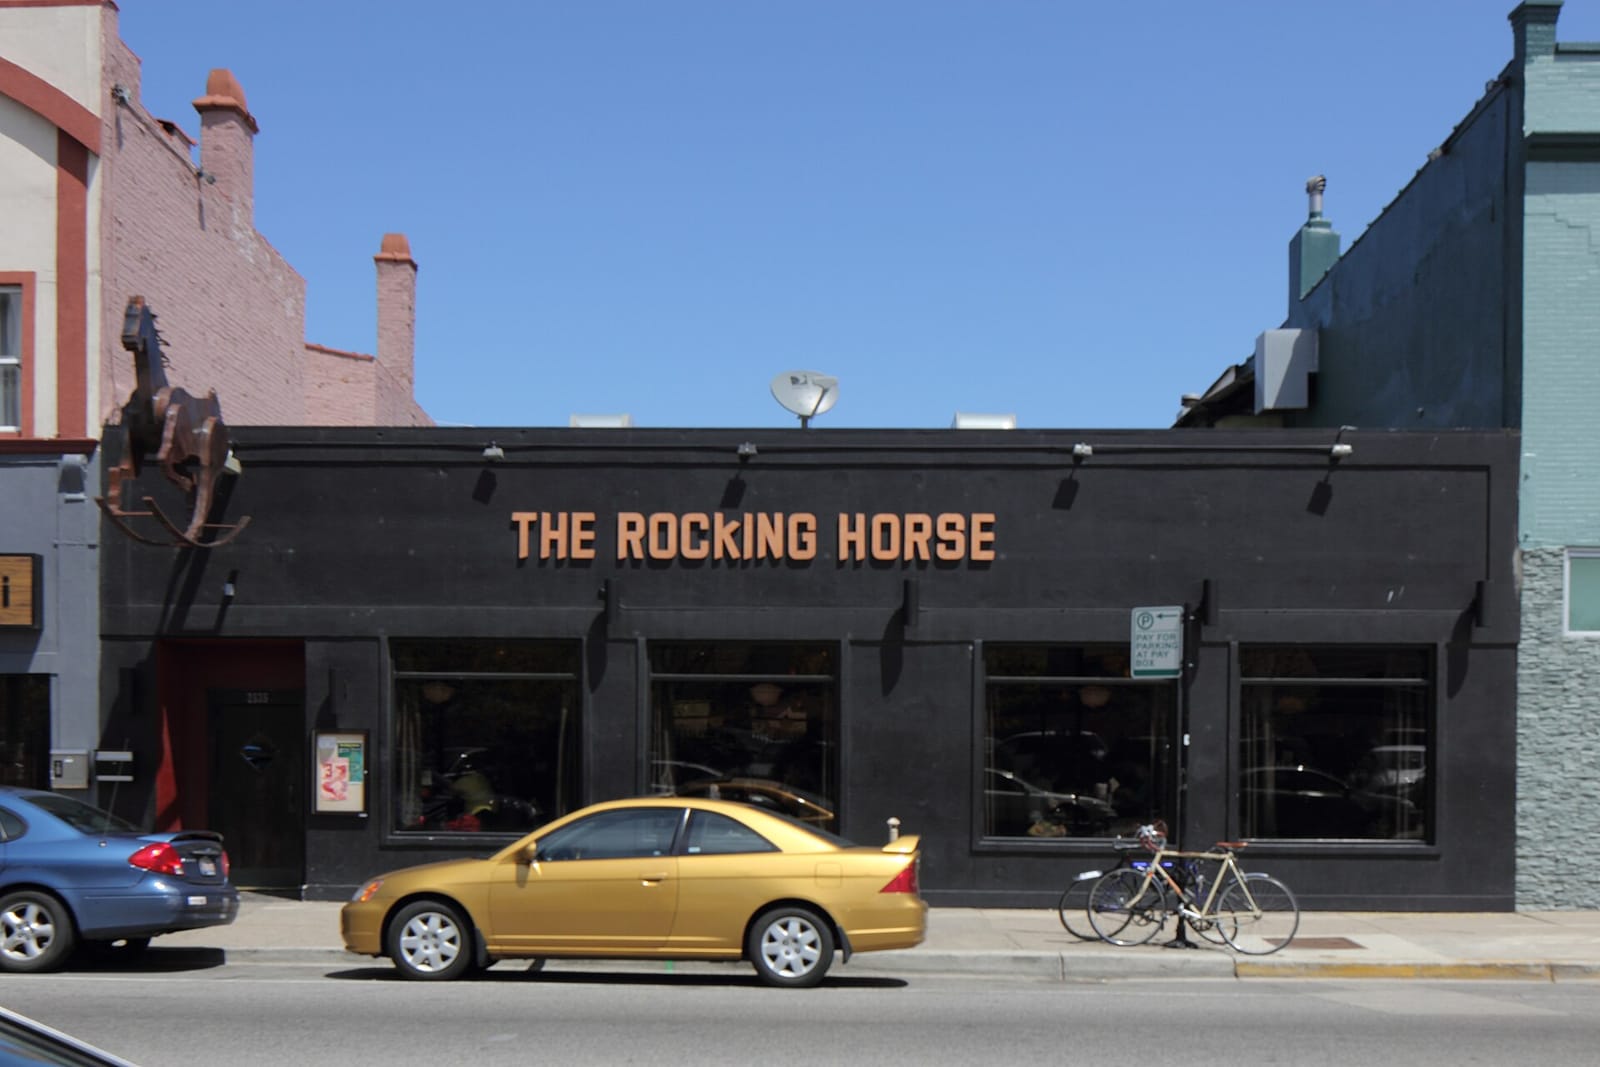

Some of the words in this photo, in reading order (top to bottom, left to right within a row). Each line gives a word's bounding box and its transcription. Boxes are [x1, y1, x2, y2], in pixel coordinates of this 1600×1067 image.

[511, 512, 596, 560] THE
[838, 512, 996, 561] HORSE
[1157, 633, 1177, 641] FOR
[1151, 650, 1169, 658] PAY
